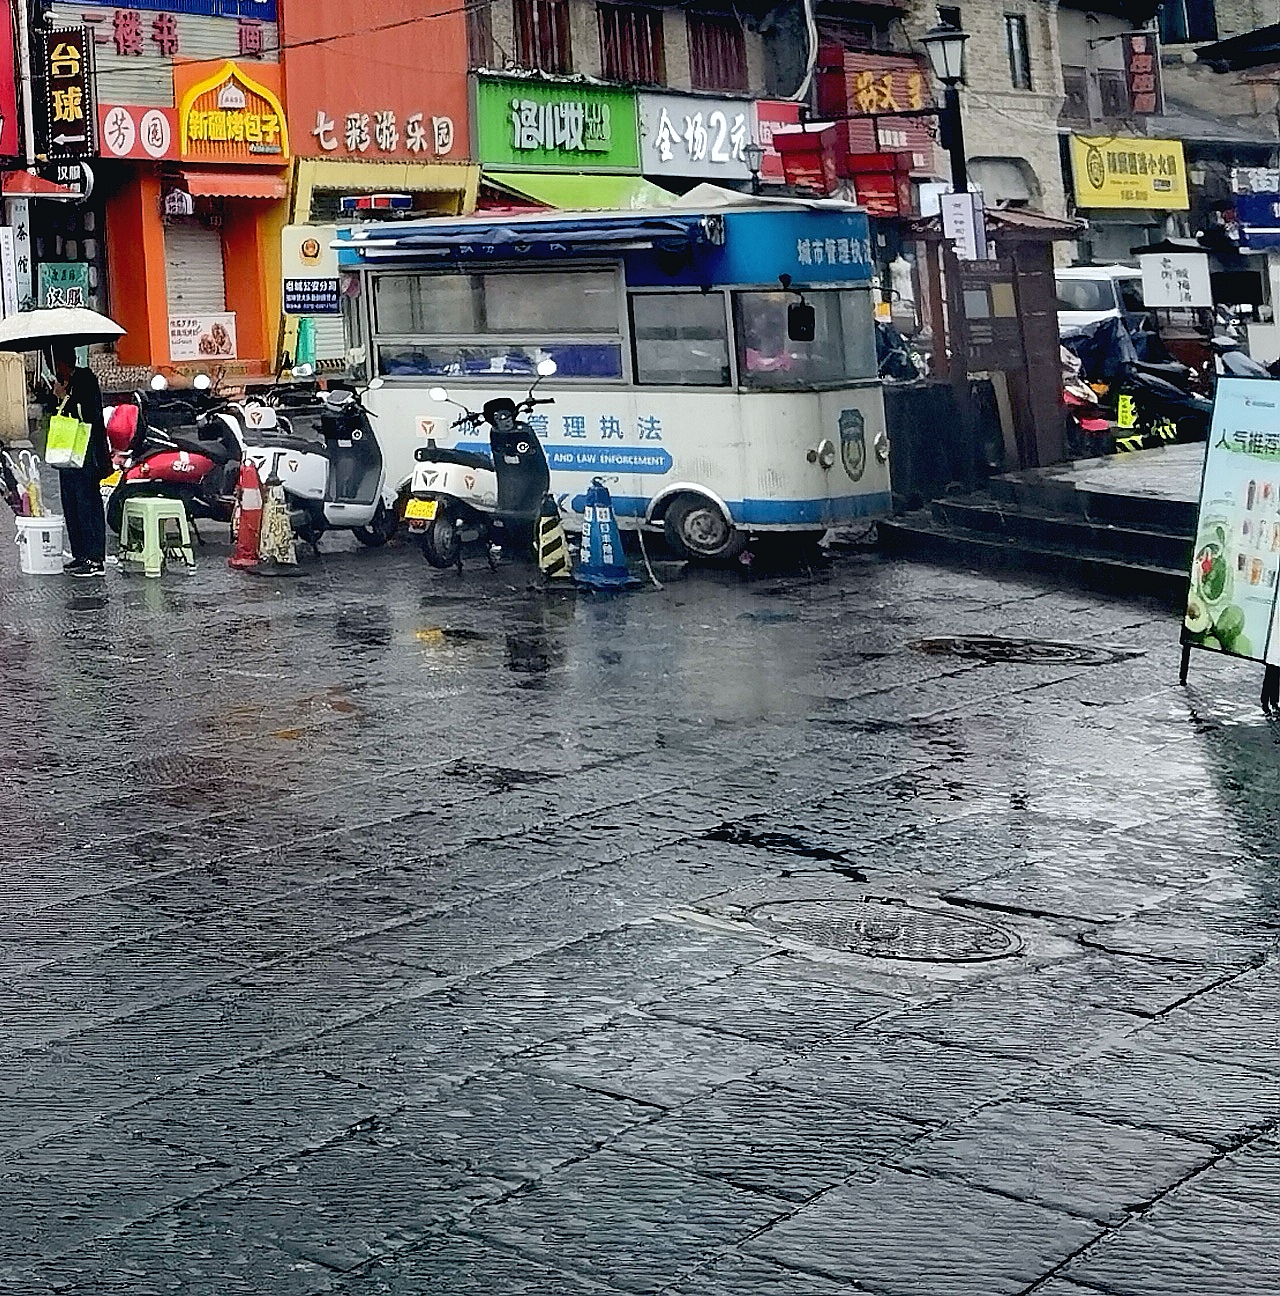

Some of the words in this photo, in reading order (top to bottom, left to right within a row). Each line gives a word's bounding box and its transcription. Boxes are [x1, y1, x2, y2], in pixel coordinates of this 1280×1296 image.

[50, 42, 84, 123] 台球
[189, 110, 280, 142] 新疆烤包子
[313, 110, 454, 155] 七彩游乐园
[656, 107, 747, 163] 全场2元
[57, 165, 81, 181] 汉服
[46, 286, 83, 307] 汉服
[554, 453, 573, 463] AND
[577, 453, 596, 464] LAW
[600, 454, 665, 466] ENFORCEMENT
